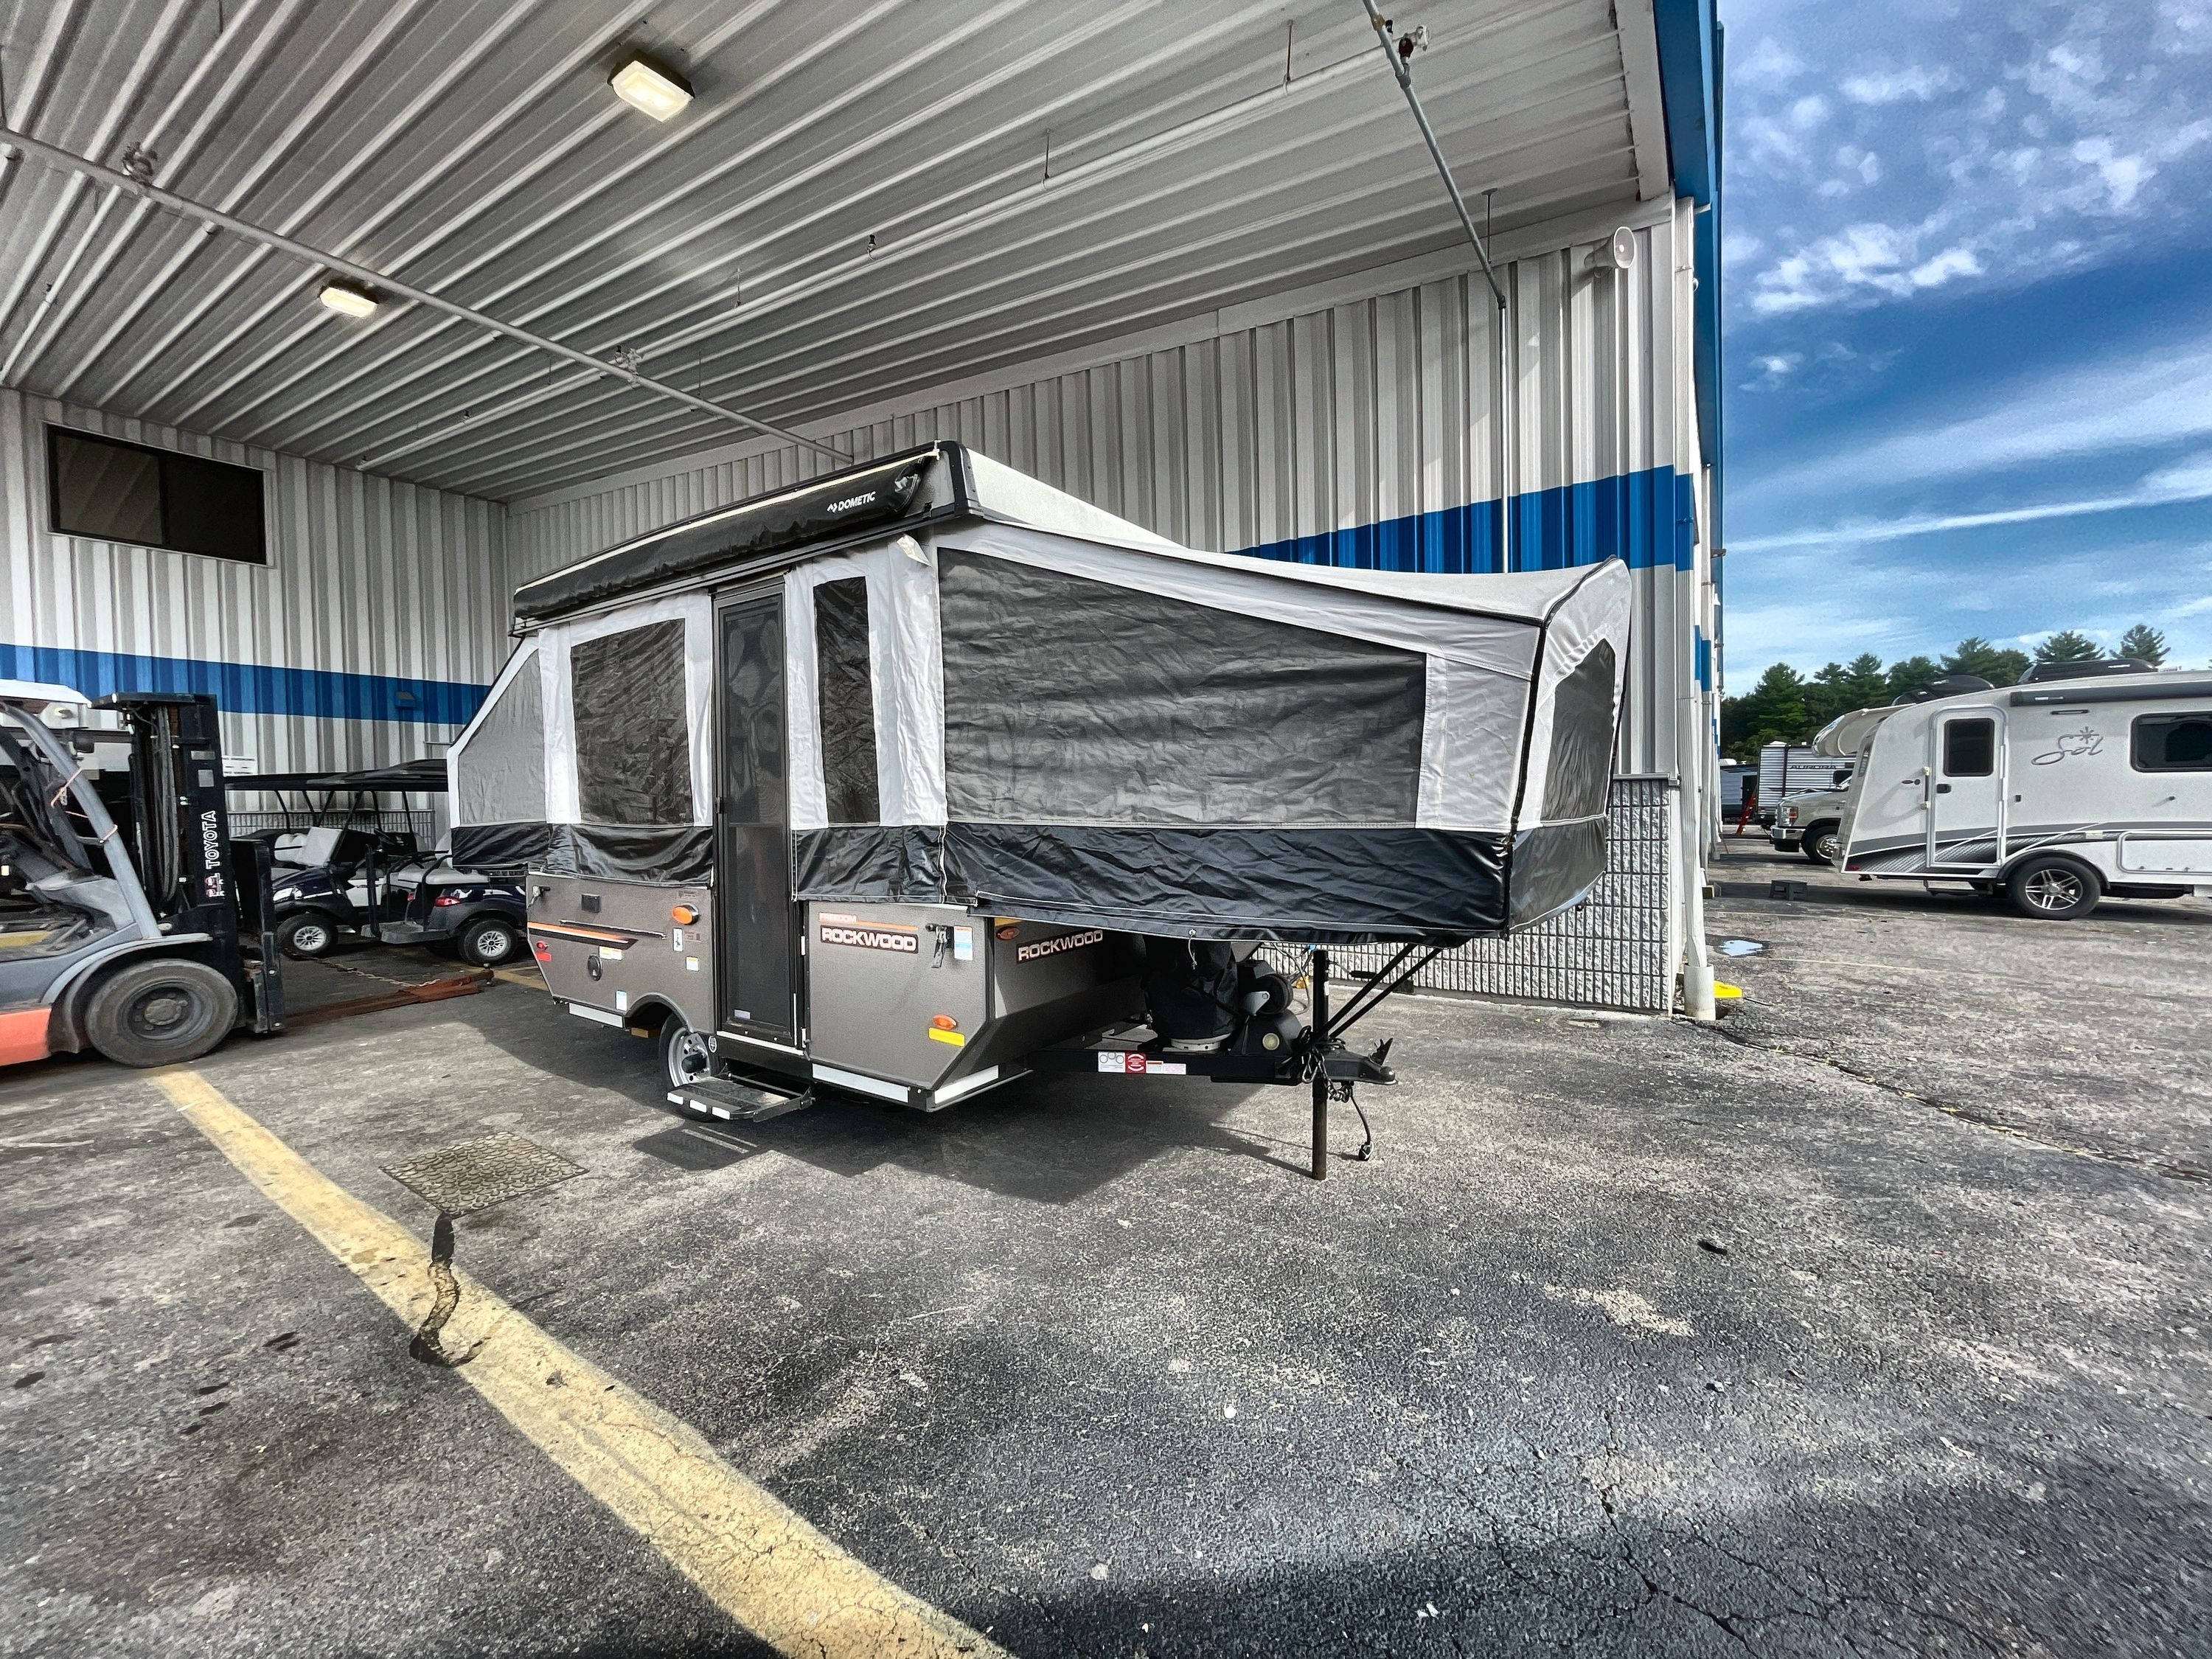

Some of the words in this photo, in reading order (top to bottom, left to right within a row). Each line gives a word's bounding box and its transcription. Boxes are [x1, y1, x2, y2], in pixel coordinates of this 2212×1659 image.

[838, 491, 876, 511] DOMETIC
[2031, 733, 2104, 765] Sol
[201, 810, 220, 869] TOYOTA
[821, 927, 917, 951] ROCKWOOD
[1018, 930, 1103, 961] ROCKWOOD
